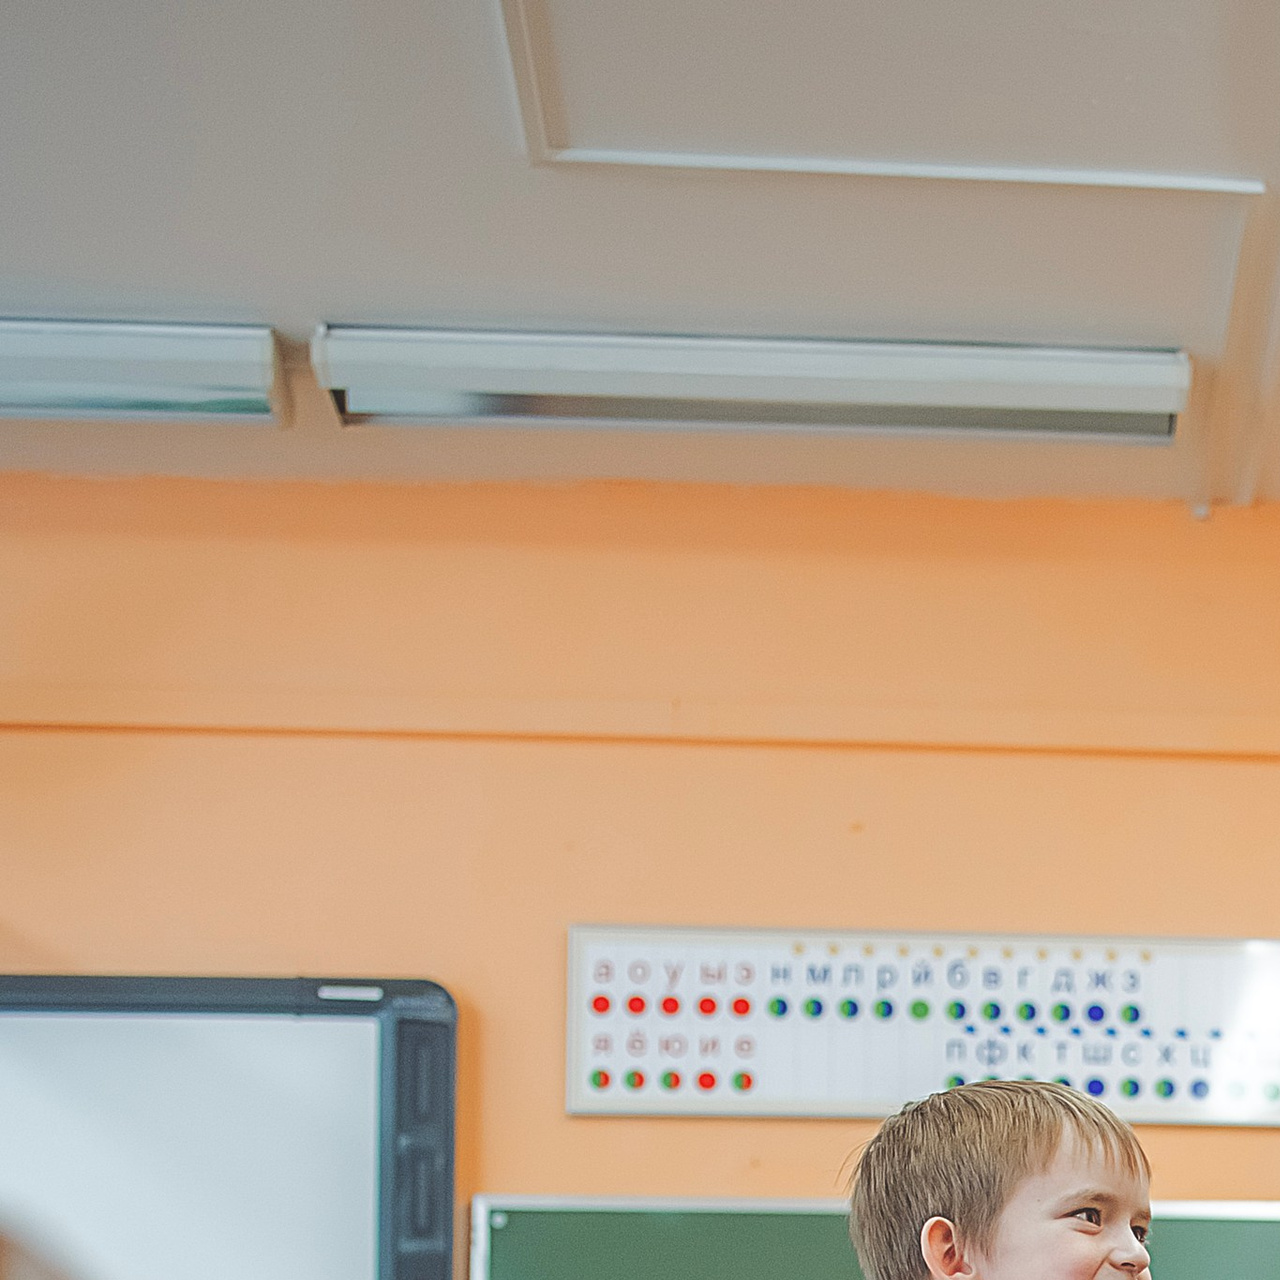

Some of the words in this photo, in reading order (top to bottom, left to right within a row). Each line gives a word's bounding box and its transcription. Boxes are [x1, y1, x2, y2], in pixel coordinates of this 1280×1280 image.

[627, 959, 651, 985] о
[663, 960, 685, 993] у
[700, 961, 727, 986] ы
[735, 960, 756, 987] э
[807, 964, 832, 987] м
[877, 964, 898, 993] р
[912, 959, 933, 987] й
[947, 958, 970, 990] б
[1052, 966, 1076, 993] д
[1088, 967, 1114, 993] ж
[658, 1033, 688, 1059] ю
[946, 1038, 967, 1063] п
[976, 1037, 1009, 1068] ф
[1016, 1039, 1034, 1065] к
[1081, 1041, 1113, 1067] ш
[1121, 1041, 1142, 1068] с
